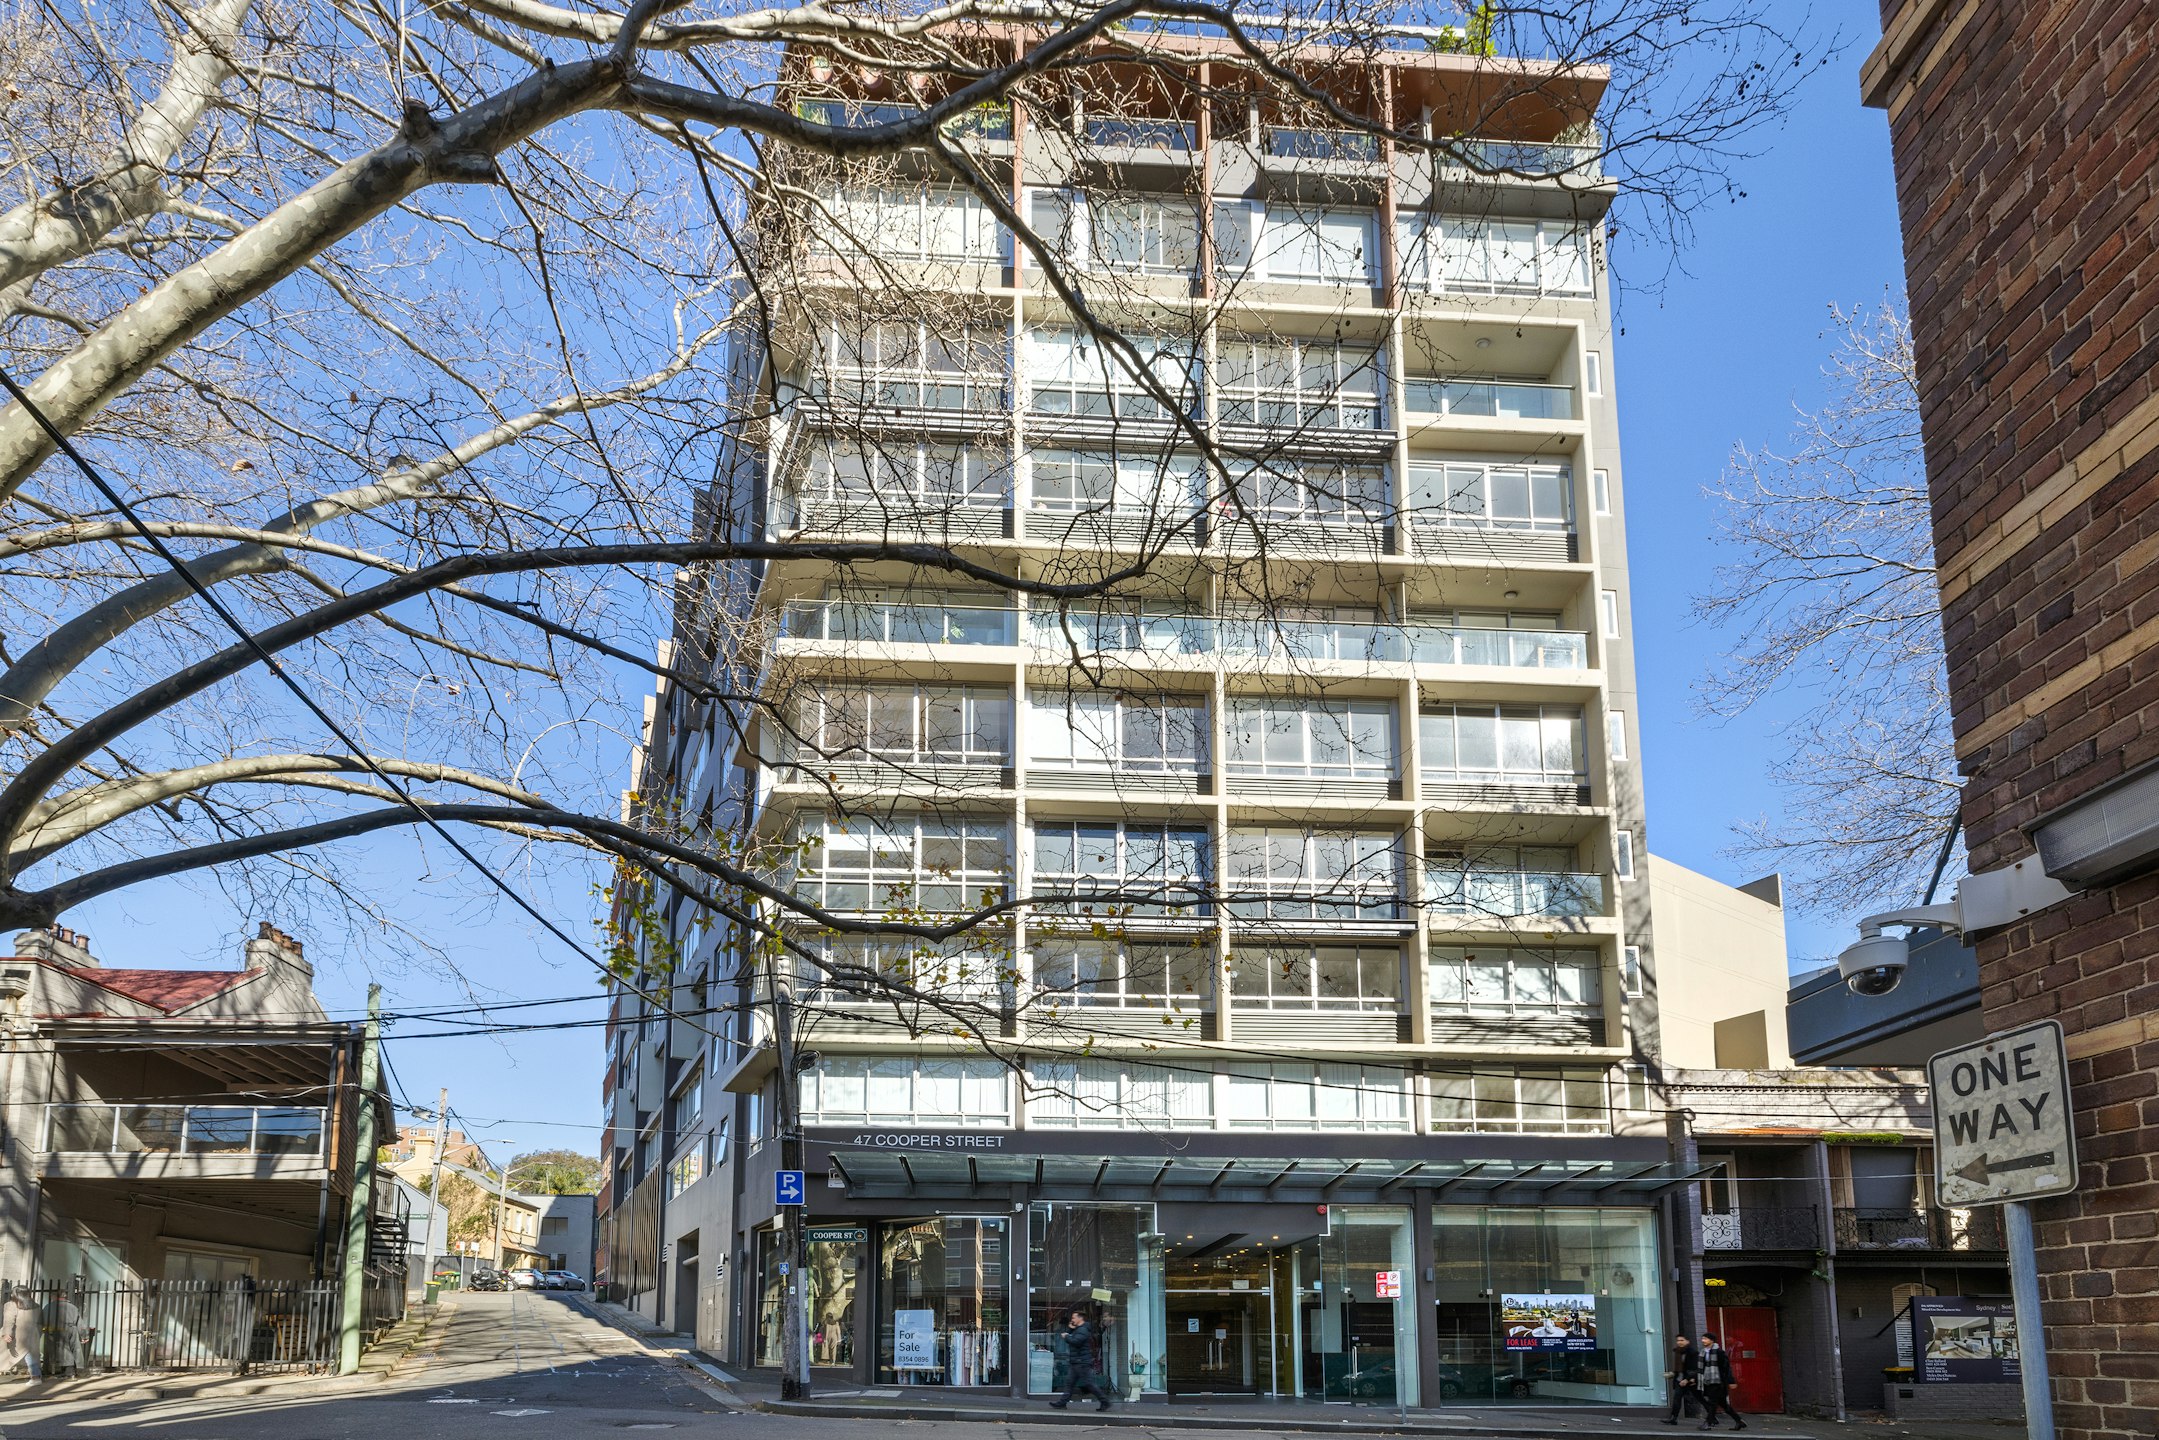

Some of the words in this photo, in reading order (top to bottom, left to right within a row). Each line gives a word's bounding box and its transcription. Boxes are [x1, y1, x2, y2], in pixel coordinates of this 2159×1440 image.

[1951, 1042, 2041, 1097] ONE
[1949, 1091, 2050, 1147] WAY
[853, 1134, 872, 1146] 47
[875, 1134, 941, 1147] COOPER
[945, 1135, 1005, 1147] STREET
[783, 1174, 796, 1188] P
[1975, 1304, 1996, 1312] Sydney
[899, 1330, 915, 1340] For
[899, 1342, 920, 1352] Sale
[1506, 1338, 1519, 1346] FOR
[1520, 1338, 1538, 1346] LEASE
